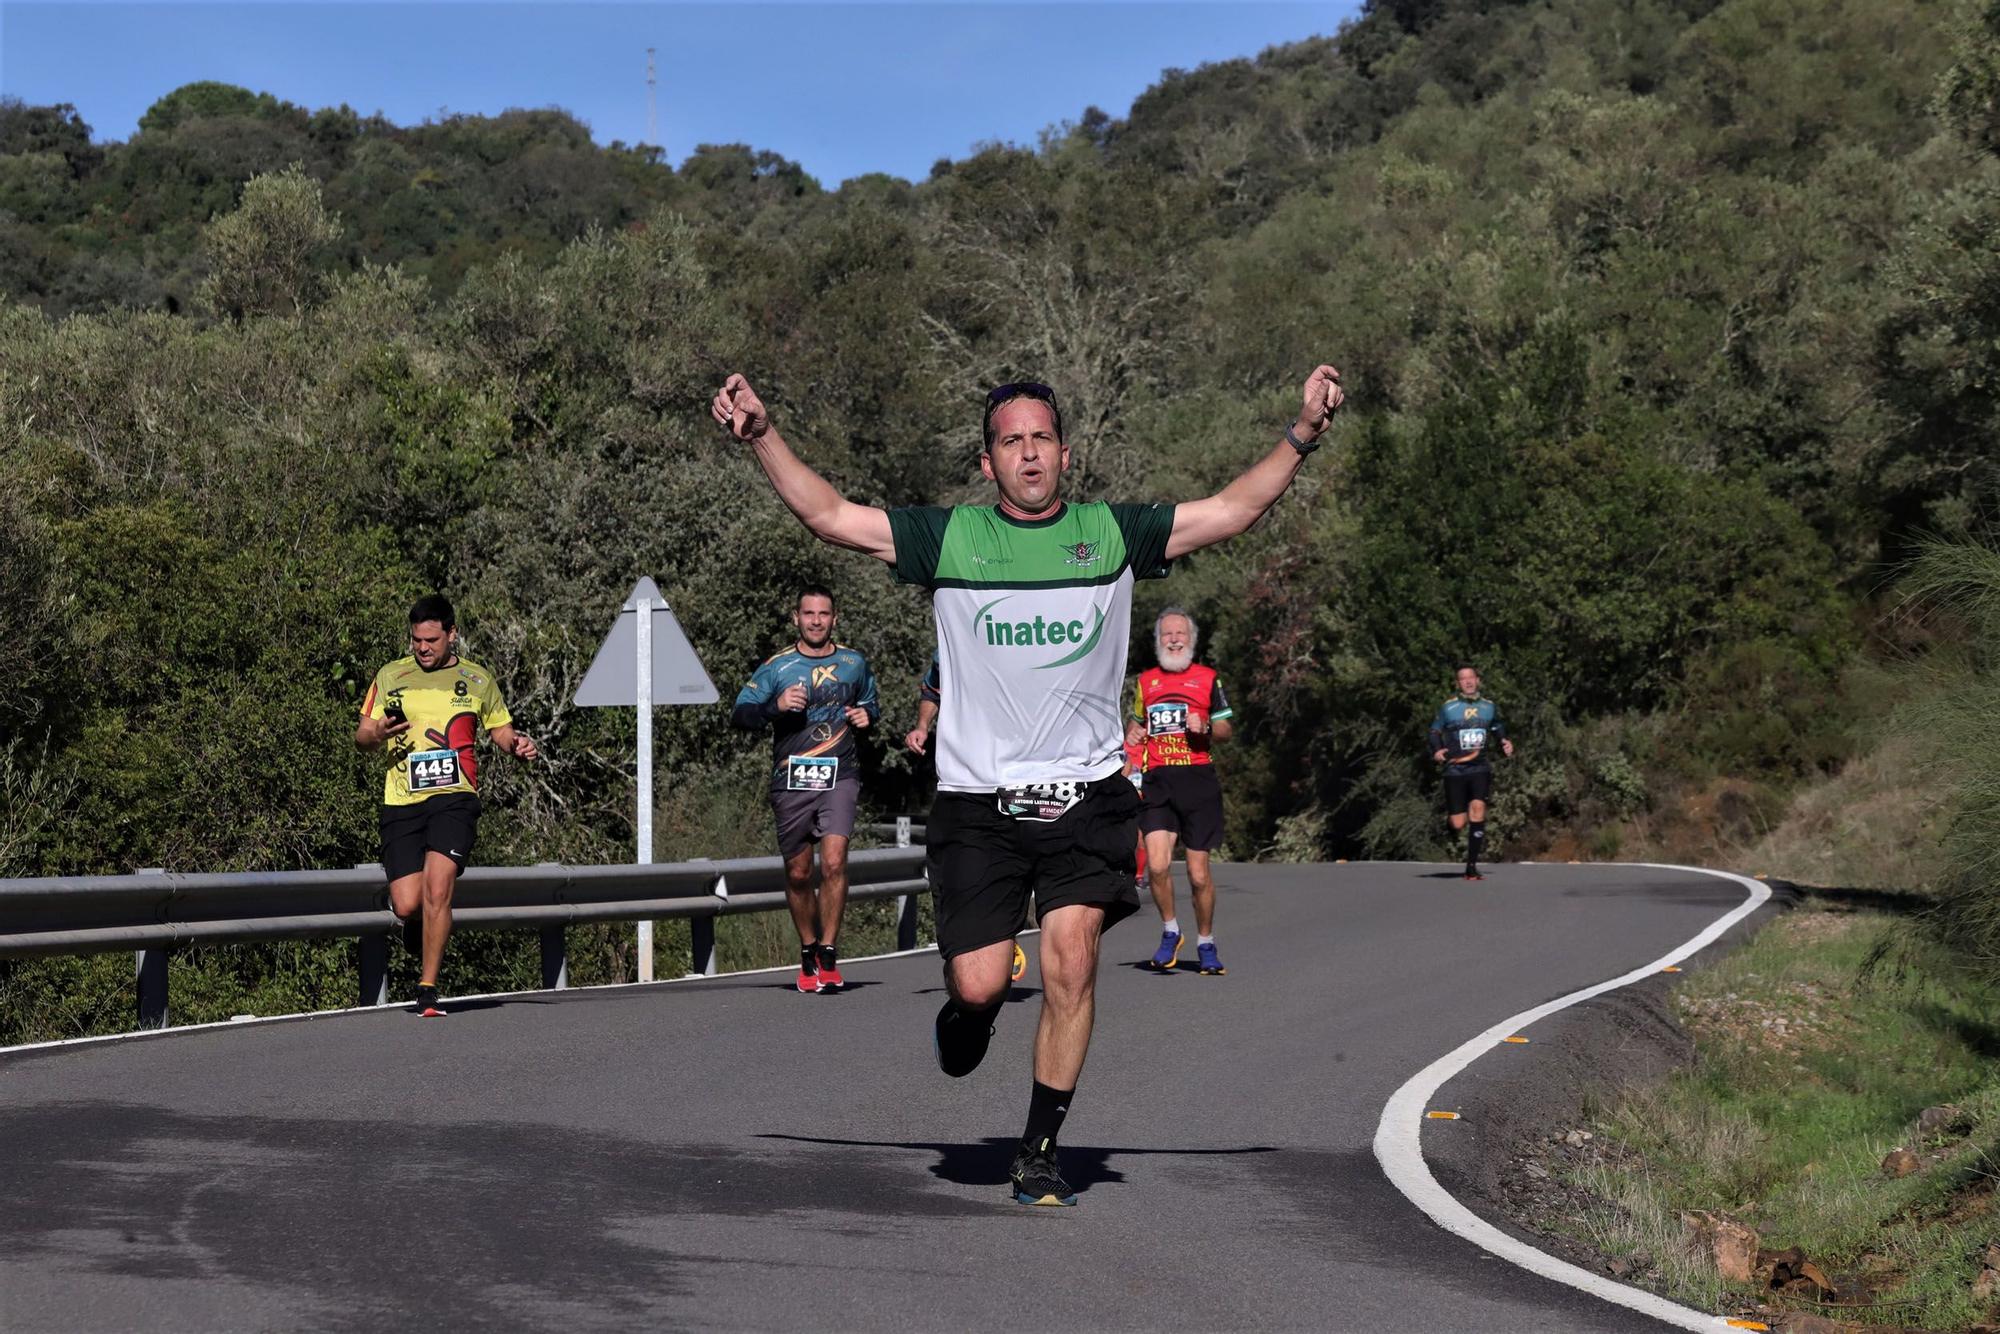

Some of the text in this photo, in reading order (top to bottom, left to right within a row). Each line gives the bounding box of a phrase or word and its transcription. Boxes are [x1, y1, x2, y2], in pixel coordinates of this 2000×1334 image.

[985, 614, 1084, 646] inatec
[454, 680, 468, 697] 8
[1151, 710, 1181, 725] 361
[414, 758, 454, 777] 445
[1163, 754, 1191, 765] Trail
[793, 765, 831, 780] 443
